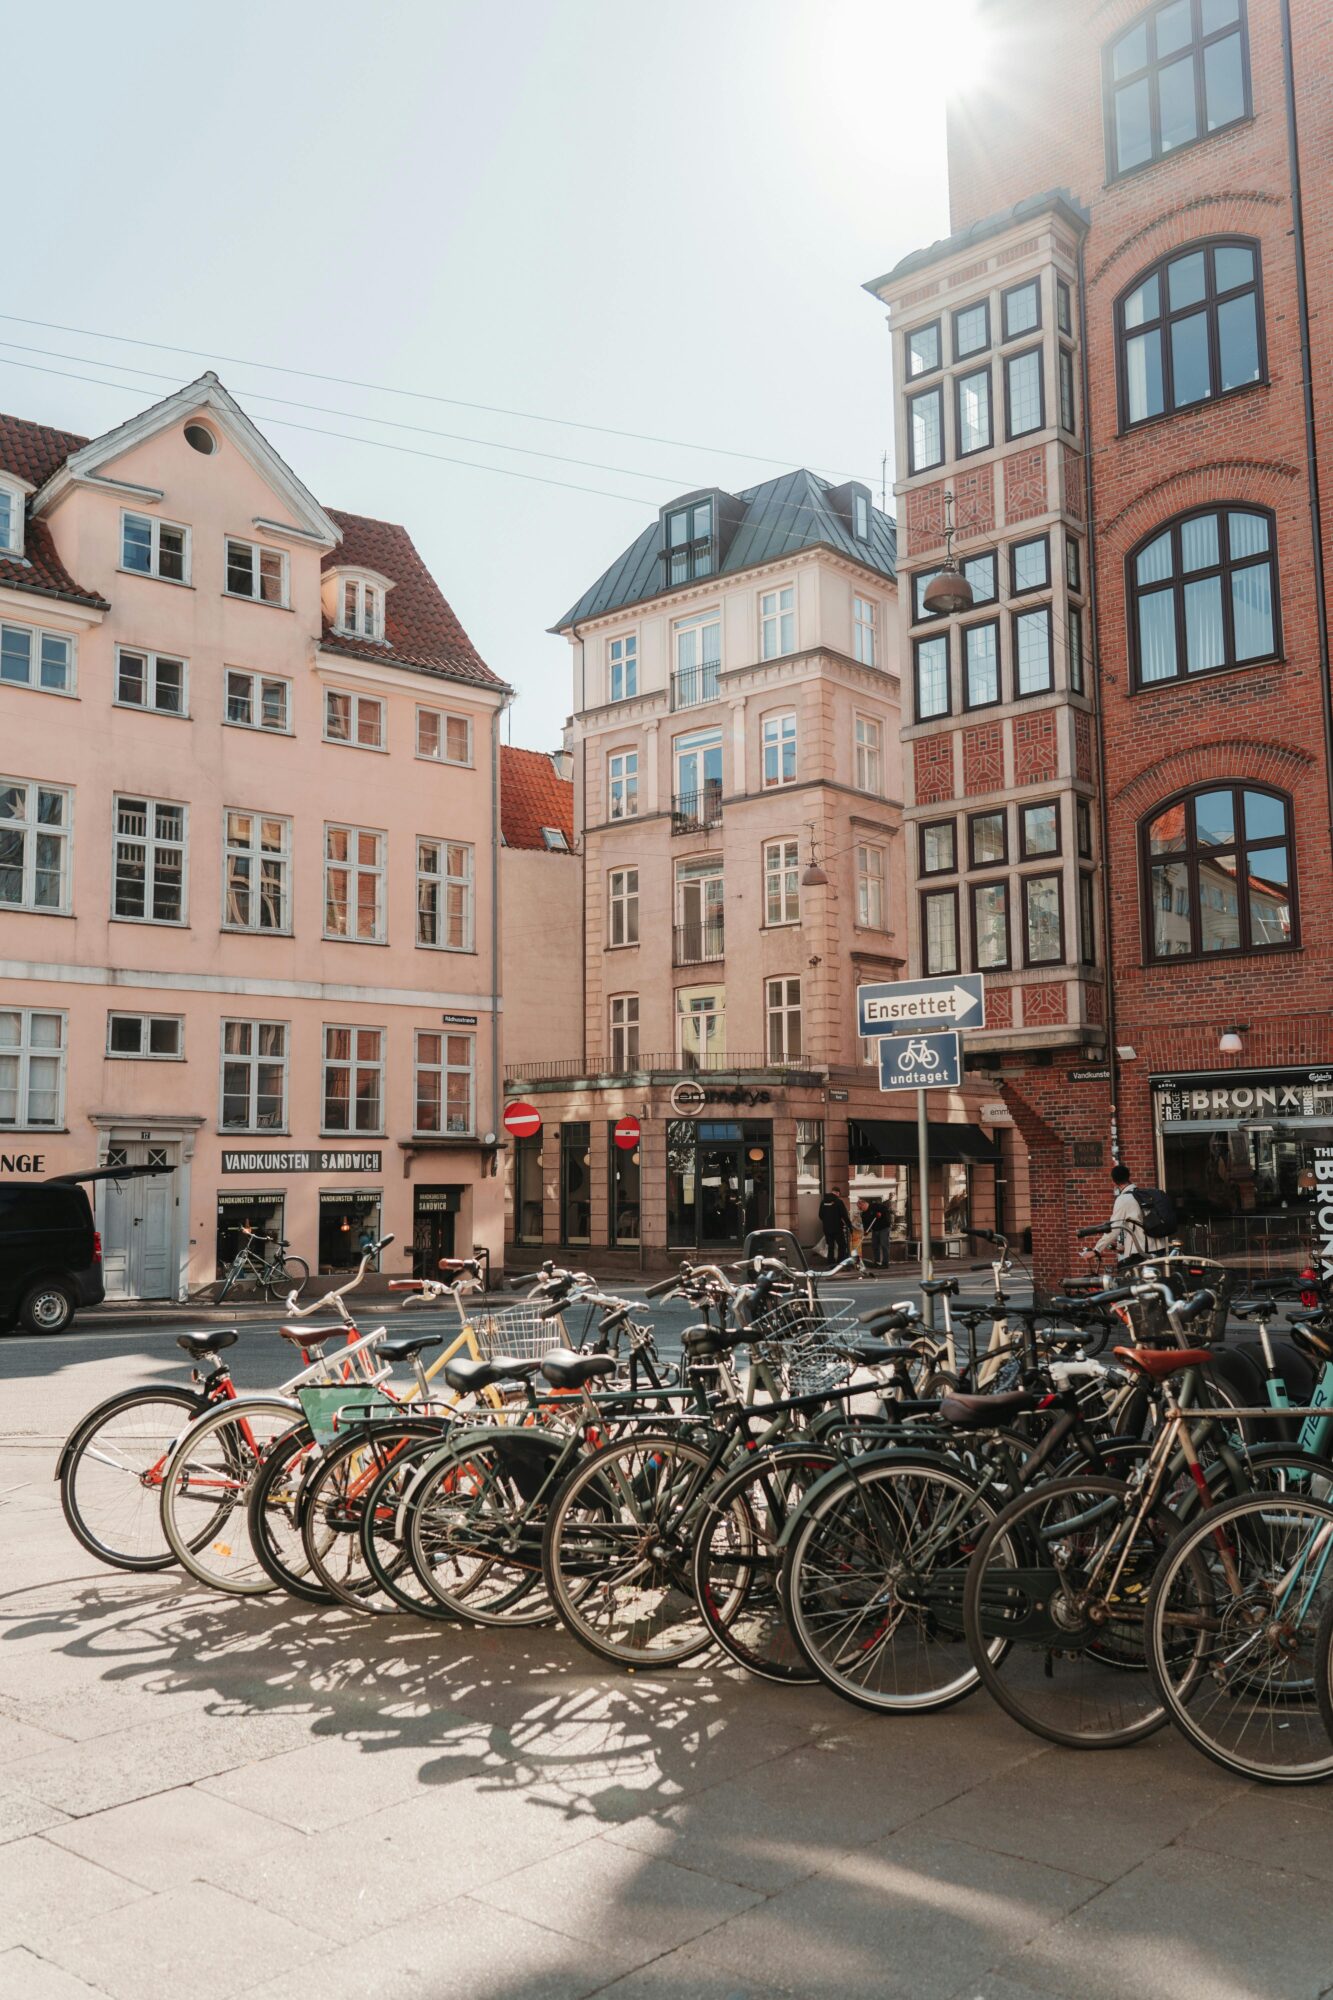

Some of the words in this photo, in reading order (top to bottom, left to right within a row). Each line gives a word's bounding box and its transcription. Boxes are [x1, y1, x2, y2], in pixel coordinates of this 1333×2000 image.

[868, 995, 956, 1019] Ensrettet
[890, 1069, 949, 1085] undtaget
[1073, 1071, 1111, 1080] Vandkunste
[1308, 1072, 1332, 1082] Carlsberg
[1182, 1090, 1190, 1110] THE
[1192, 1085, 1300, 1110] BRONX
[225, 1153, 309, 1170] VANDKUNSTEN
[321, 1153, 379, 1169] SANDWICH
[418, 1202, 447, 1210] SANDWICH
[1301, 1389, 1328, 1448] TIER
